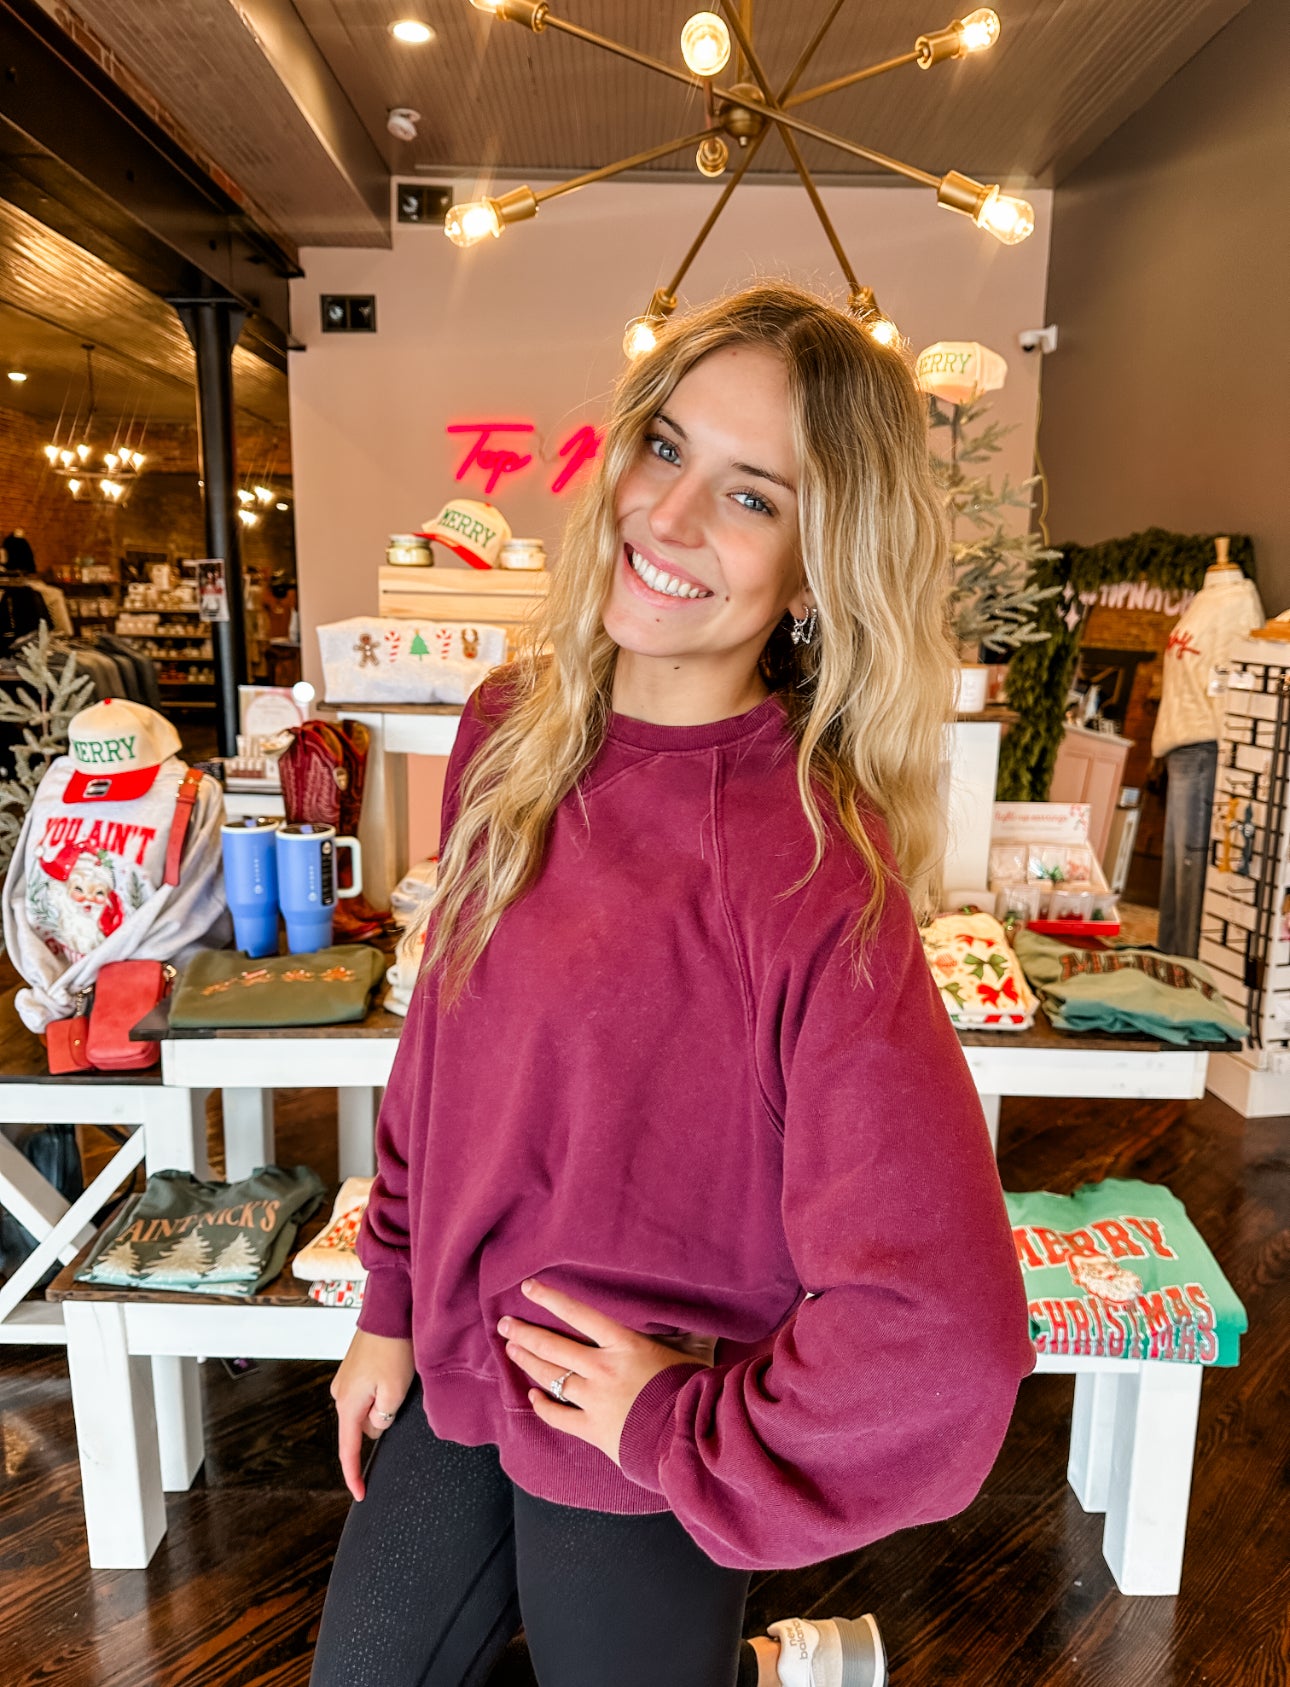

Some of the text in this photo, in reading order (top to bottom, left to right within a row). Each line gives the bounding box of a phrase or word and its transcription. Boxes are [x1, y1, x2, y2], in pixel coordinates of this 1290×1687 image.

[447, 423, 535, 494] Top
[39, 817, 157, 866] YOU AIN'T
[198, 1199, 281, 1233] NICK'S
